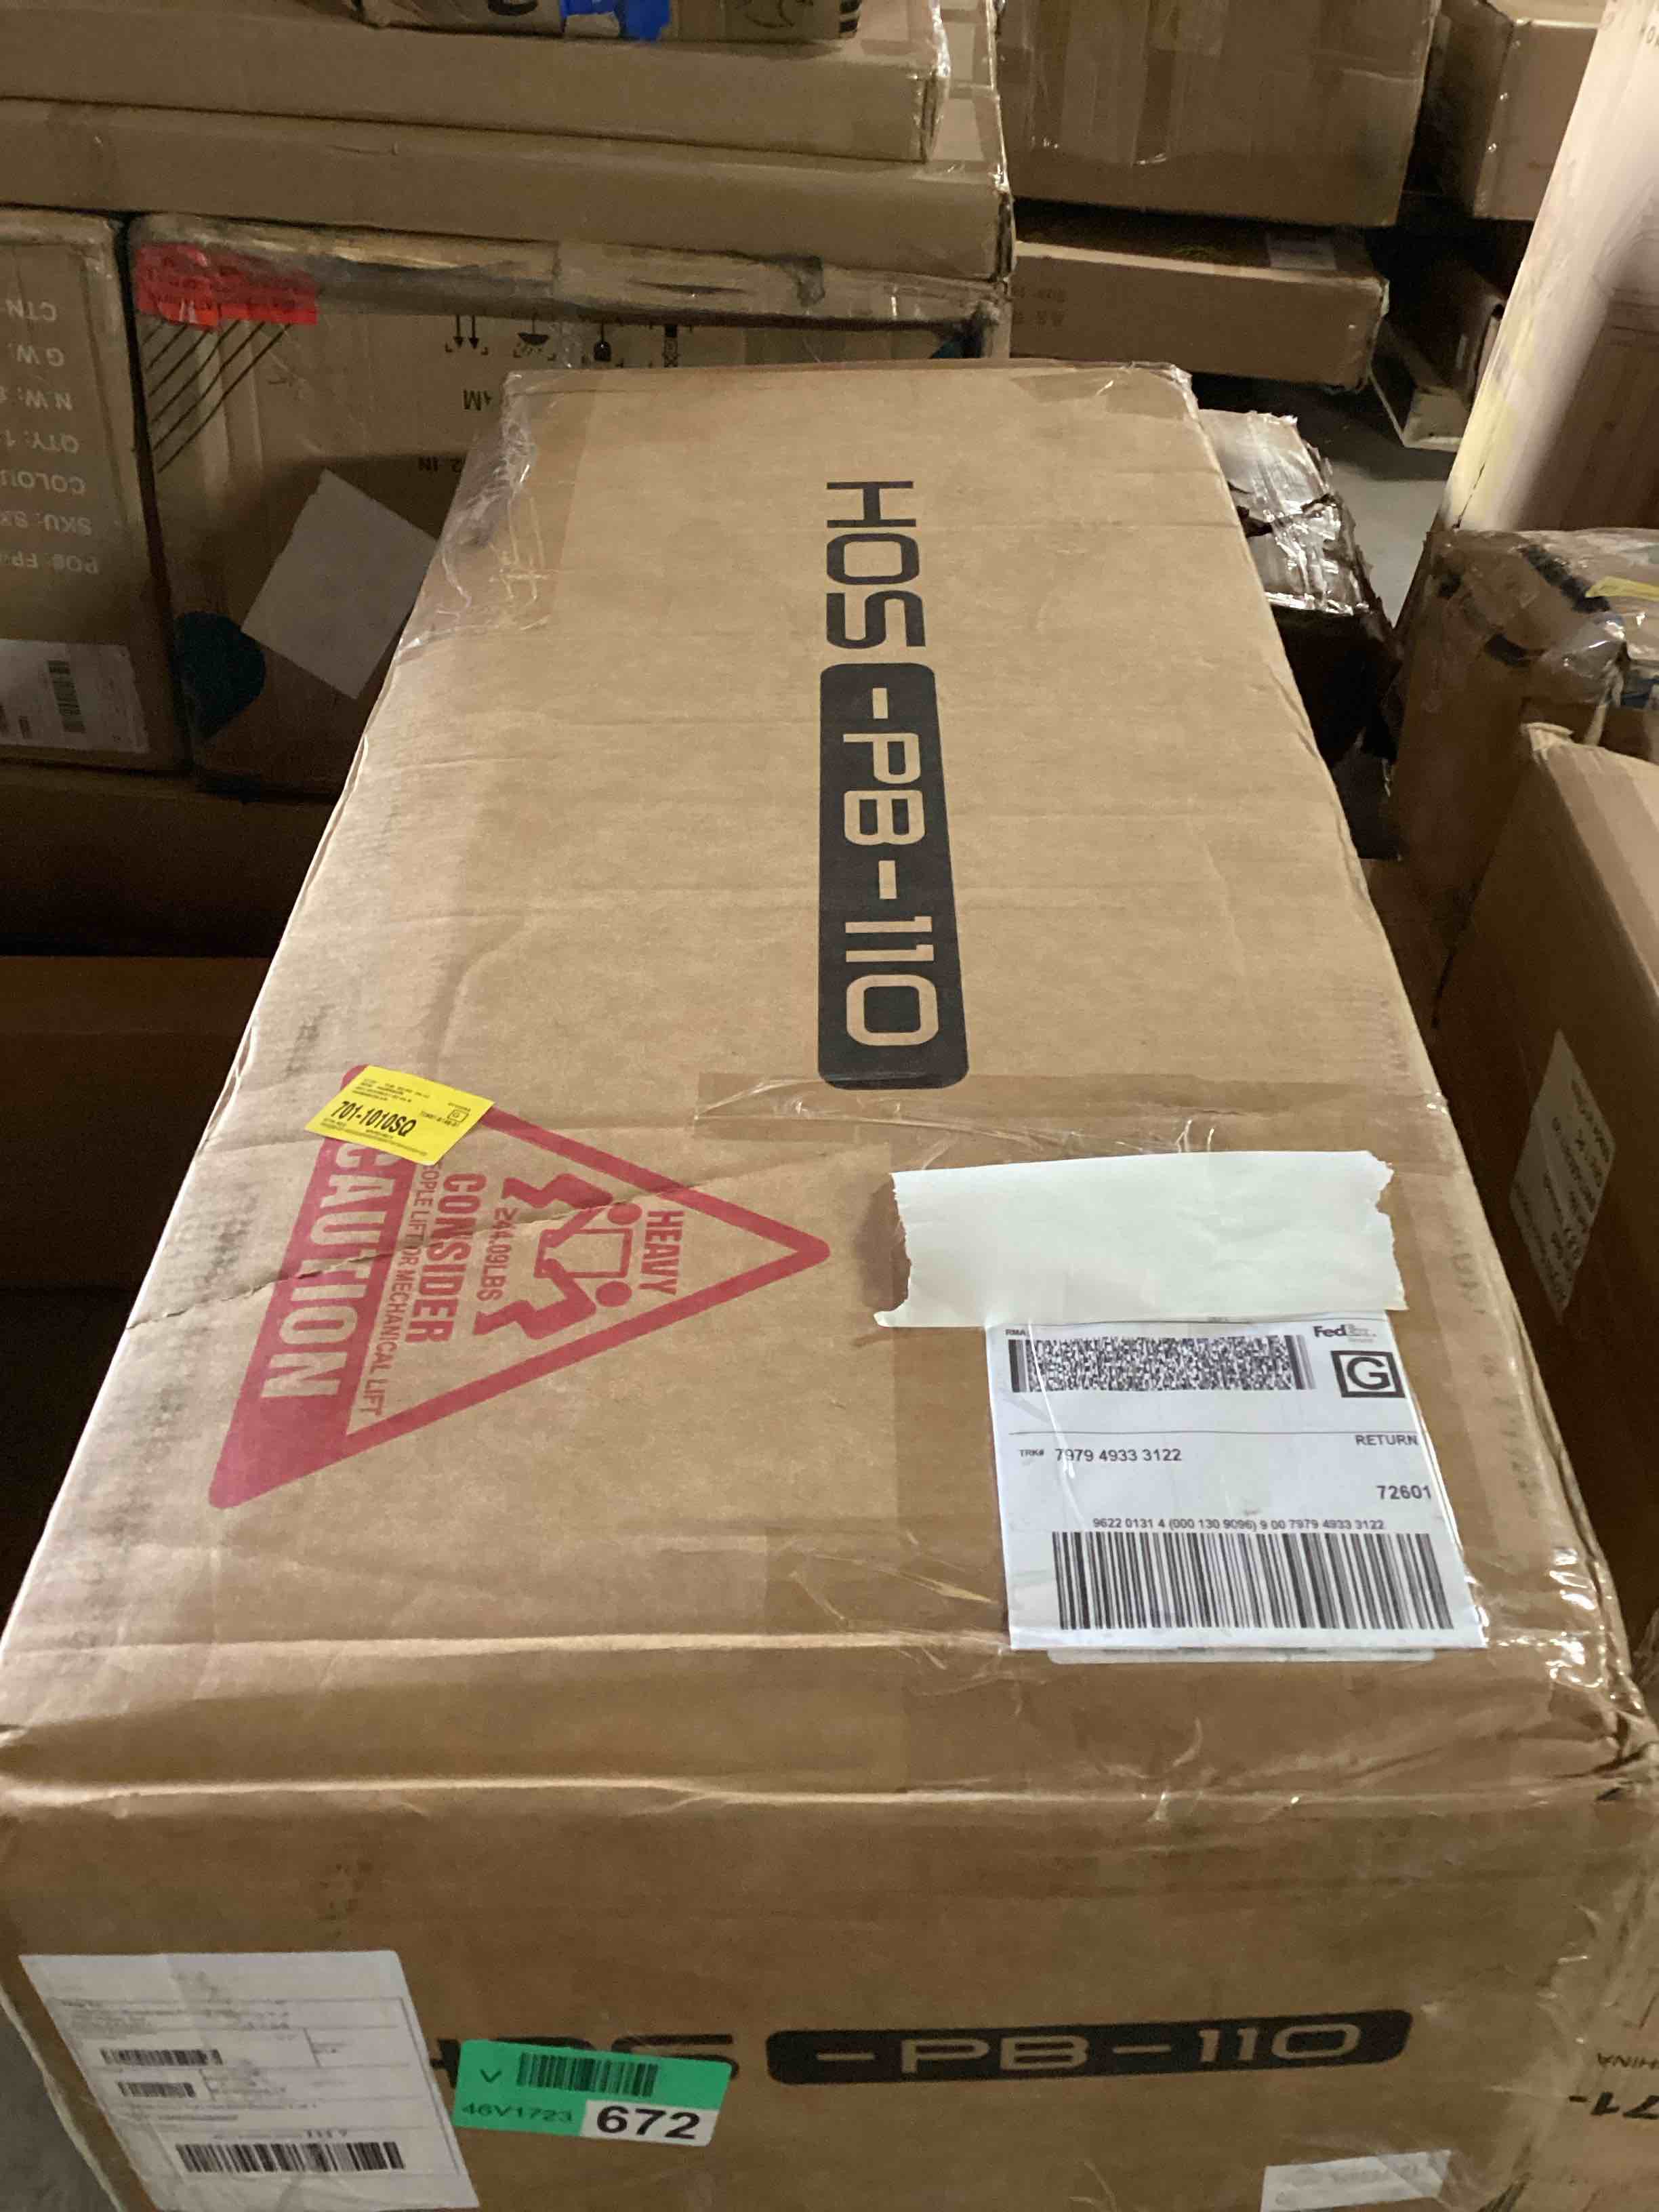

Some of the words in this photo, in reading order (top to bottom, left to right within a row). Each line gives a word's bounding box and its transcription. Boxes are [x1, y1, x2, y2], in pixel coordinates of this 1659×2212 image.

[826, 480, 926, 649] HOS
[331, 1100, 417, 1137] 701-1010SQ
[407, 1210, 430, 1239] LIFT
[405, 1172, 487, 1343] CONSIDER
[640, 1209, 685, 1296] HEAVY
[369, 1269, 416, 1375] MECHANICAL
[1346, 1356, 1391, 1391] G
[359, 1378, 386, 1417] LIFT
[1019, 1448, 1046, 1458] TRK#
[1055, 1448, 1094, 1462] 7979
[1099, 1448, 1138, 1462] 4933
[1143, 1448, 1183, 1462] 3122
[1355, 1433, 1419, 1446] RETURN
[1376, 1484, 1432, 1500] 72601
[1125, 1518, 1153, 1529] 0131
[1158, 1519, 1166, 1529] 4
[1290, 1519, 1319, 1530] 7979
[1322, 1519, 1352, 1530] 4933
[1355, 1519, 1385, 1530] 3122
[596, 2105, 701, 2139] 672
